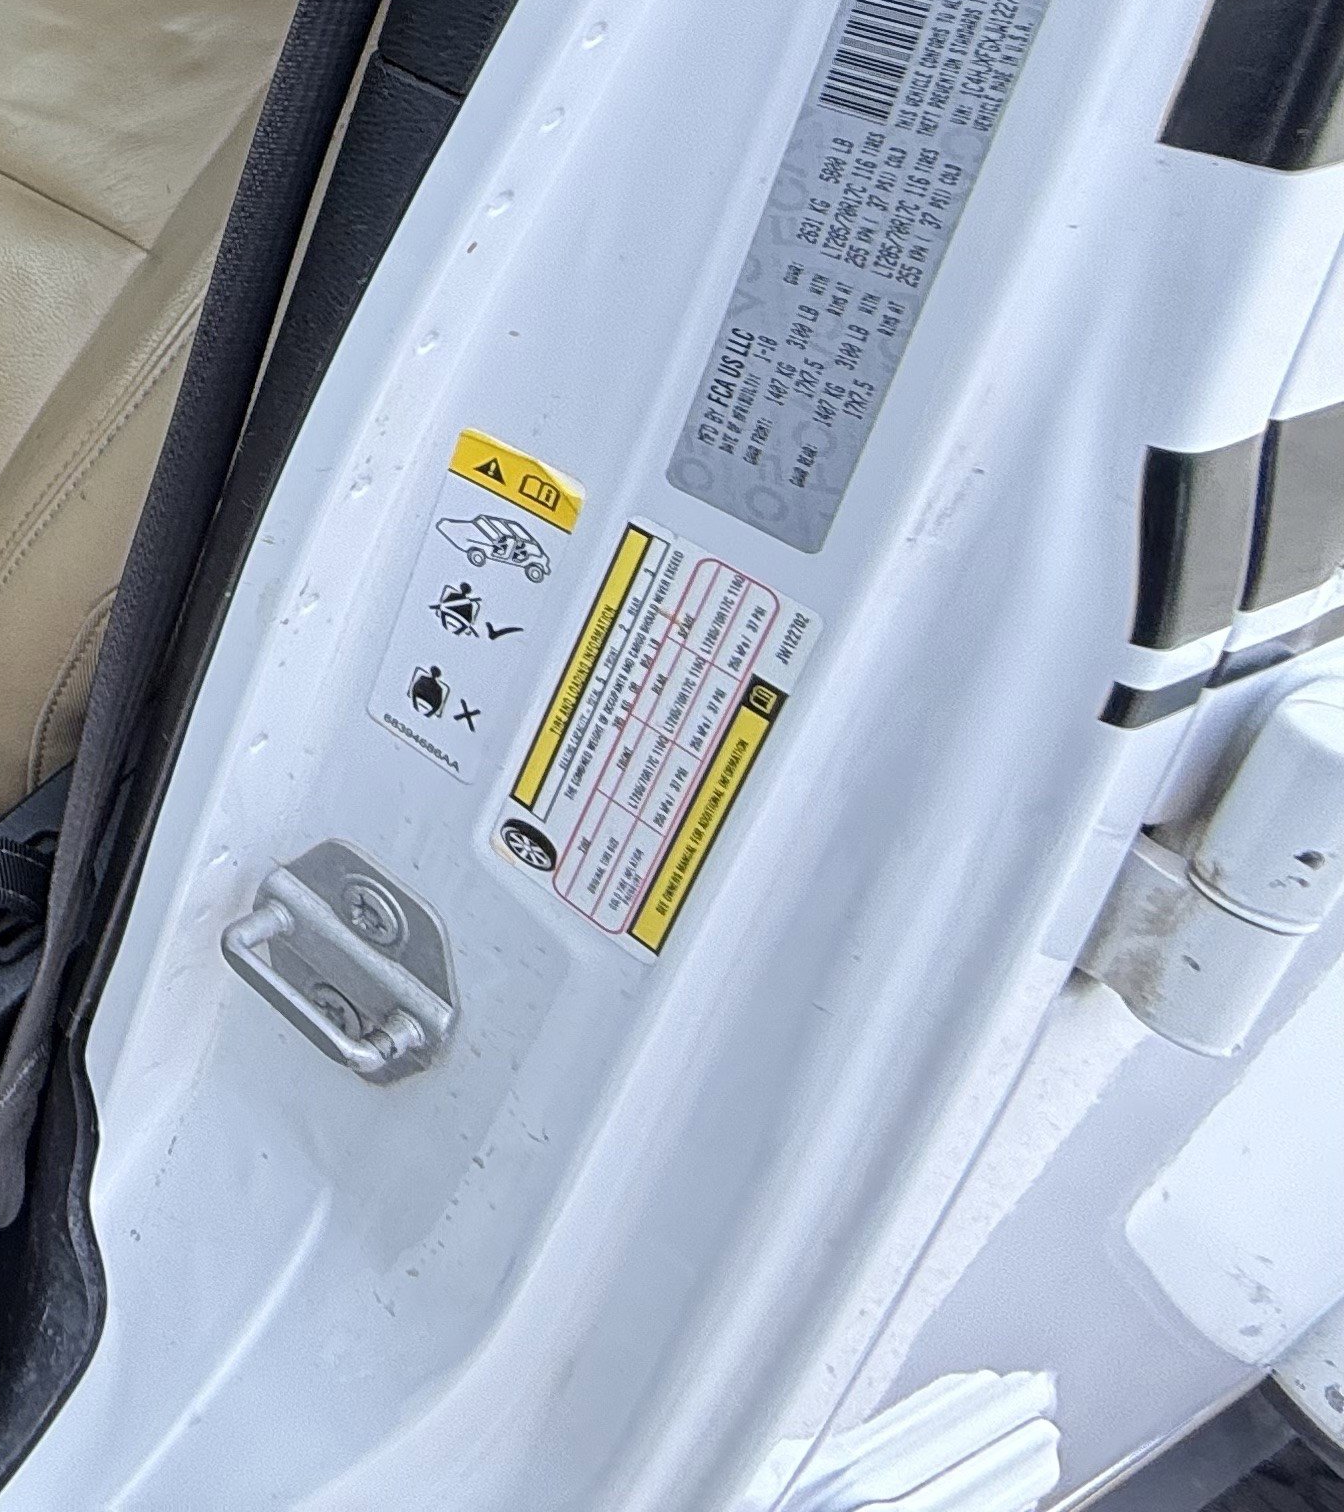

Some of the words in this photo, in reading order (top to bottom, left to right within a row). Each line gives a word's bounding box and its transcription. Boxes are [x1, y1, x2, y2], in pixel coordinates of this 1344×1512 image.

[917, 25, 951, 70] CONFORMS
[947, 6, 984, 56] STANDARDS
[902, 70, 933, 108] VEHICLE
[926, 56, 964, 110] PREVENTION
[971, 93, 1003, 133] VEHICLE
[987, 68, 1014, 94] MADE
[1003, 18, 1035, 54] U.S.A.
[894, 108, 918, 131] THIS
[915, 110, 942, 138] THEFT
[949, 102, 974, 126] VIN:
[751, 333, 778, 363] 1-18
[795, 215, 824, 244] 2631
[818, 153, 848, 185] 5800
[792, 356, 825, 399] 17X7.5
[843, 244, 870, 269] 255
[883, 145, 908, 169] COLD
[763, 377, 791, 407] 1407
[785, 320, 813, 351] 3100
[819, 181, 868, 261] LT285/70R17C
[849, 157, 877, 181] 116
[811, 397, 839, 428] 1407
[833, 340, 863, 371] 3100
[870, 198, 921, 279] LT285/70R17C
[902, 173, 931, 197] 116
[840, 377, 875, 420] 17X7.5
[894, 261, 923, 288] 255
[937, 162, 962, 187] COLD
[706, 374, 736, 408] FCA
[724, 326, 755, 358] LLC
[662, 548, 684, 580] EXCEED
[651, 577, 671, 605] NEVER
[581, 603, 616, 663] INFORMATION
[638, 602, 660, 634] SHOULD
[773, 611, 810, 665] JW122702
[620, 656, 636, 675] AND
[627, 631, 647, 659] CARGO
[565, 659, 591, 700] LOADING
[601, 671, 628, 715] OCCUPANTS
[548, 714, 567, 737] TIRE
[557, 696, 575, 718] AND
[563, 783, 577, 800] THE
